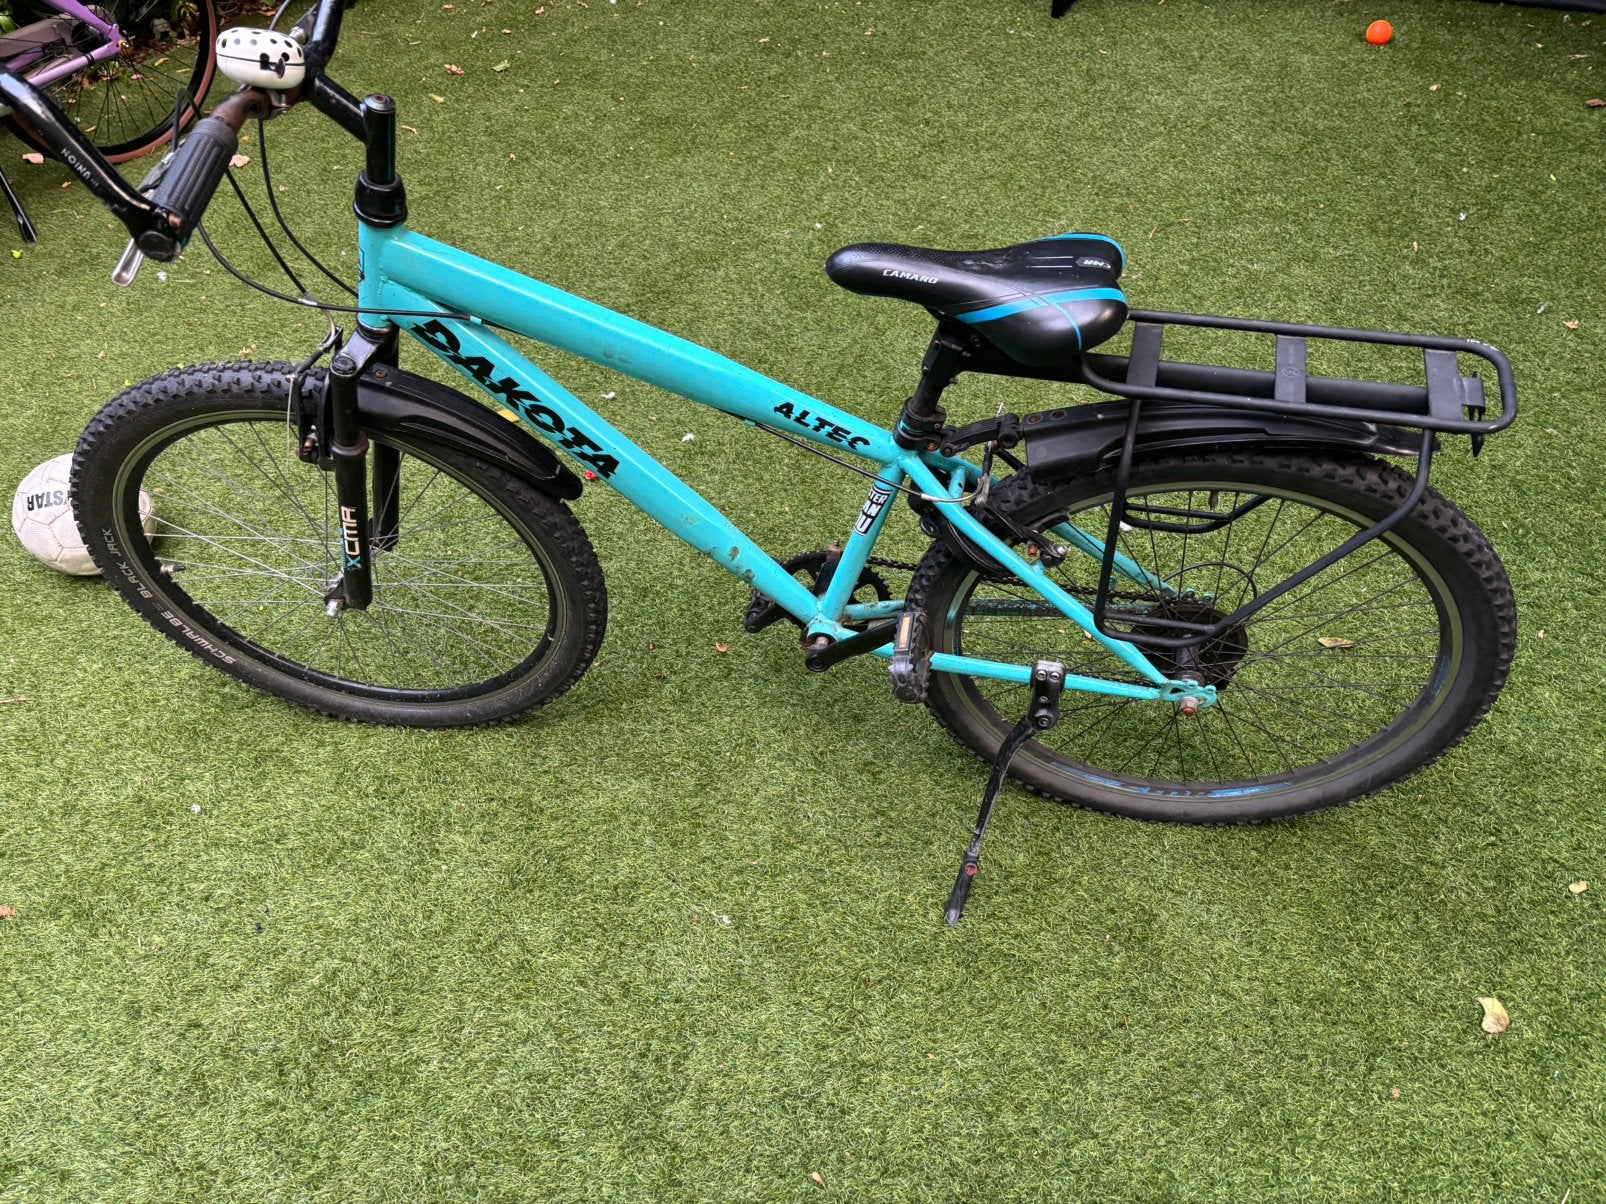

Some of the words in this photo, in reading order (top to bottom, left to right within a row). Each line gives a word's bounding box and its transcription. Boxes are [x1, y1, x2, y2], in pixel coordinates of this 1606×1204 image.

[61, 148, 91, 180] UNION
[882, 269, 939, 284] CAMARO
[410, 319, 620, 480] DAKOTA
[773, 401, 871, 451] ALTEC
[101, 528, 122, 557] JACK
[116, 561, 153, 599] BLACK
[161, 610, 238, 664] SCHWALBE
